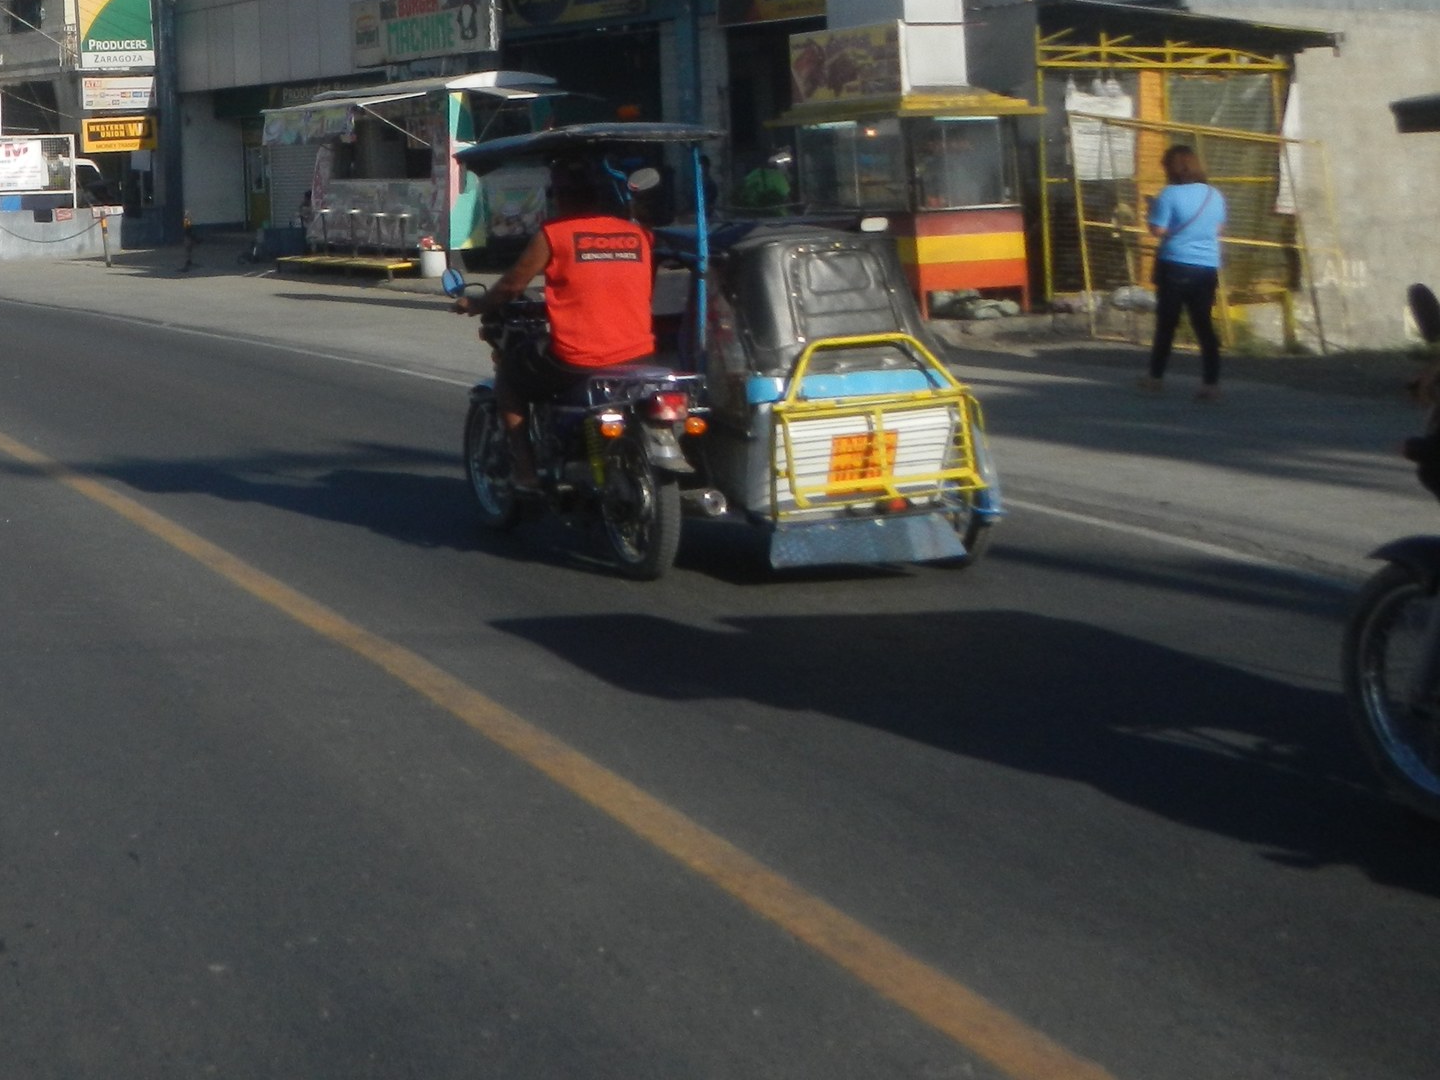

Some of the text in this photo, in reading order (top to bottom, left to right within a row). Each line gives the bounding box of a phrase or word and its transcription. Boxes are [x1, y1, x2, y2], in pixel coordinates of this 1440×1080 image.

[386, 12, 456, 56] MACHINE
[88, 39, 148, 51] PRODUCERS
[94, 54, 144, 64] ZARAGOZA
[89, 124, 125, 133] WESTERN
[100, 130, 126, 138] UNION
